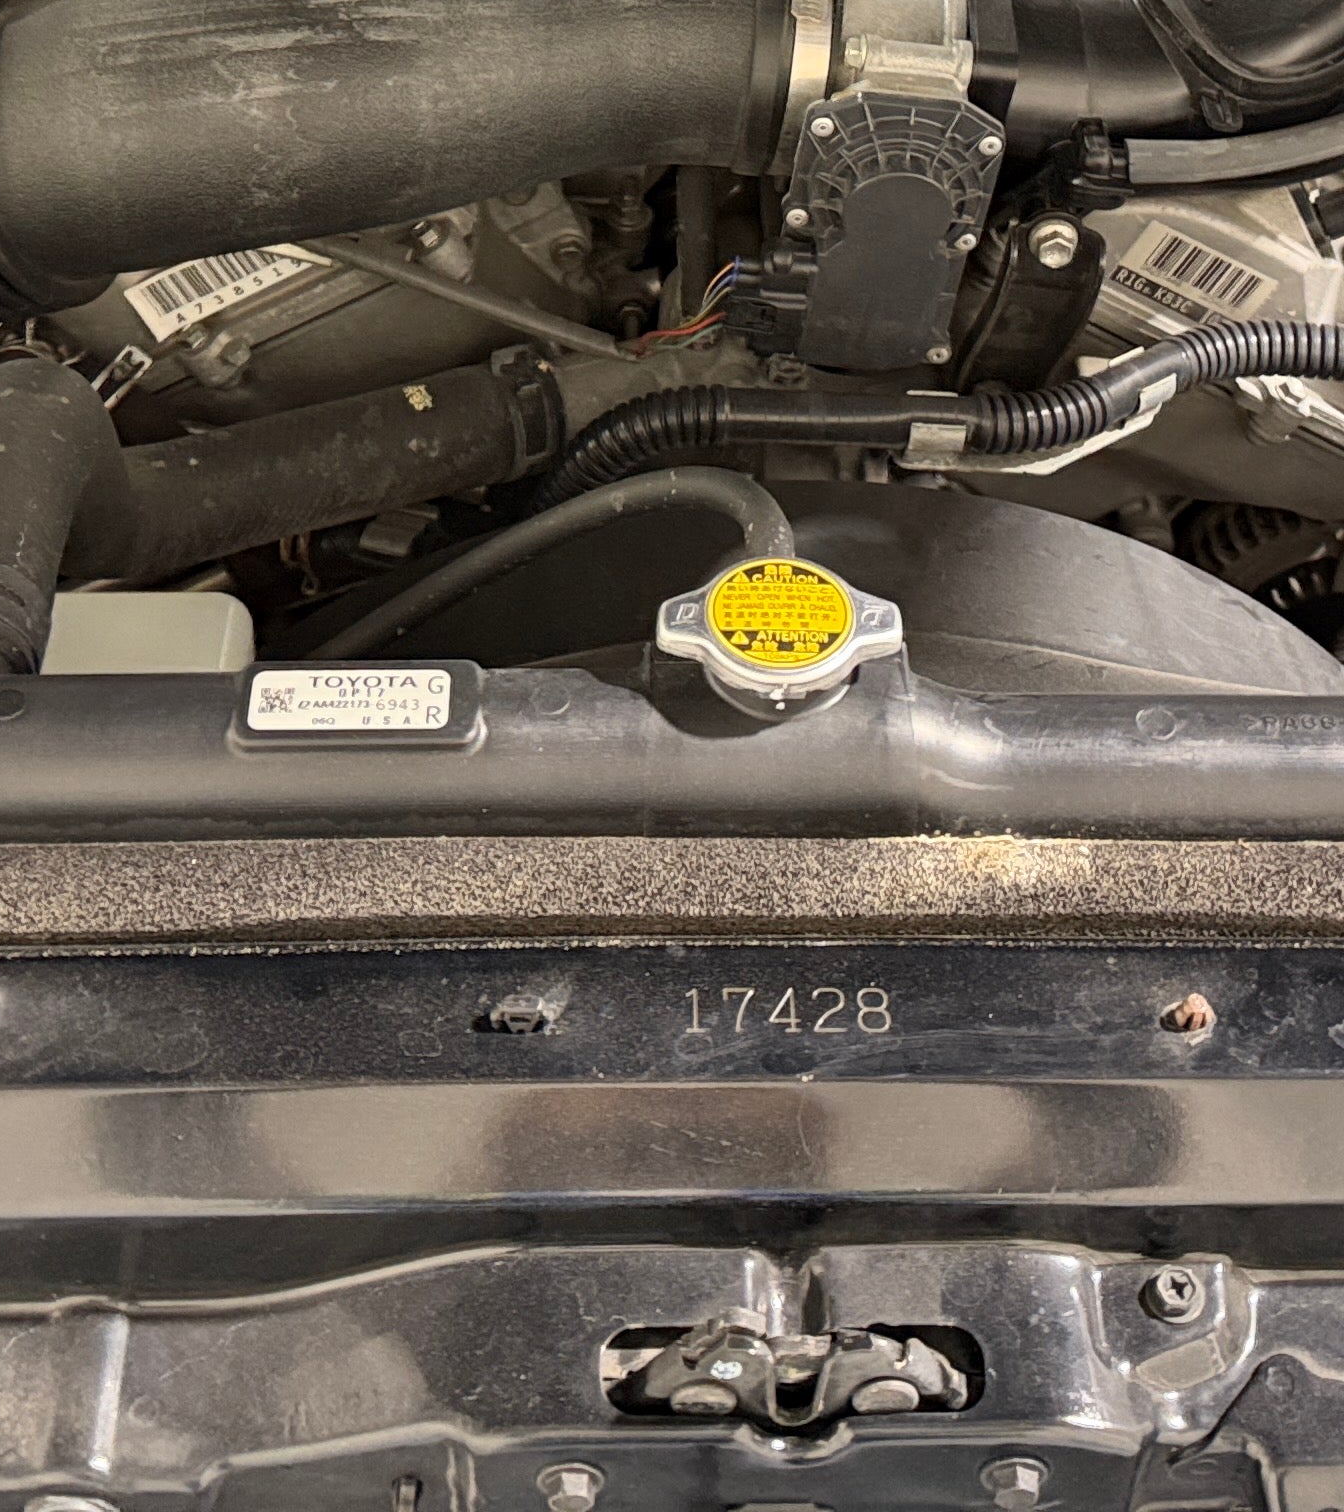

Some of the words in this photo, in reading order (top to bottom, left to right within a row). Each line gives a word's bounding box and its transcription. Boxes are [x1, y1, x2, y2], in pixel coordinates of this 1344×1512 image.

[752, 574, 818, 585] CAUTION
[757, 630, 829, 643] ATTENTION
[308, 676, 418, 688] TOYOTA
[427, 676, 445, 694] G
[425, 706, 442, 724] R
[685, 987, 892, 1034] 17428
